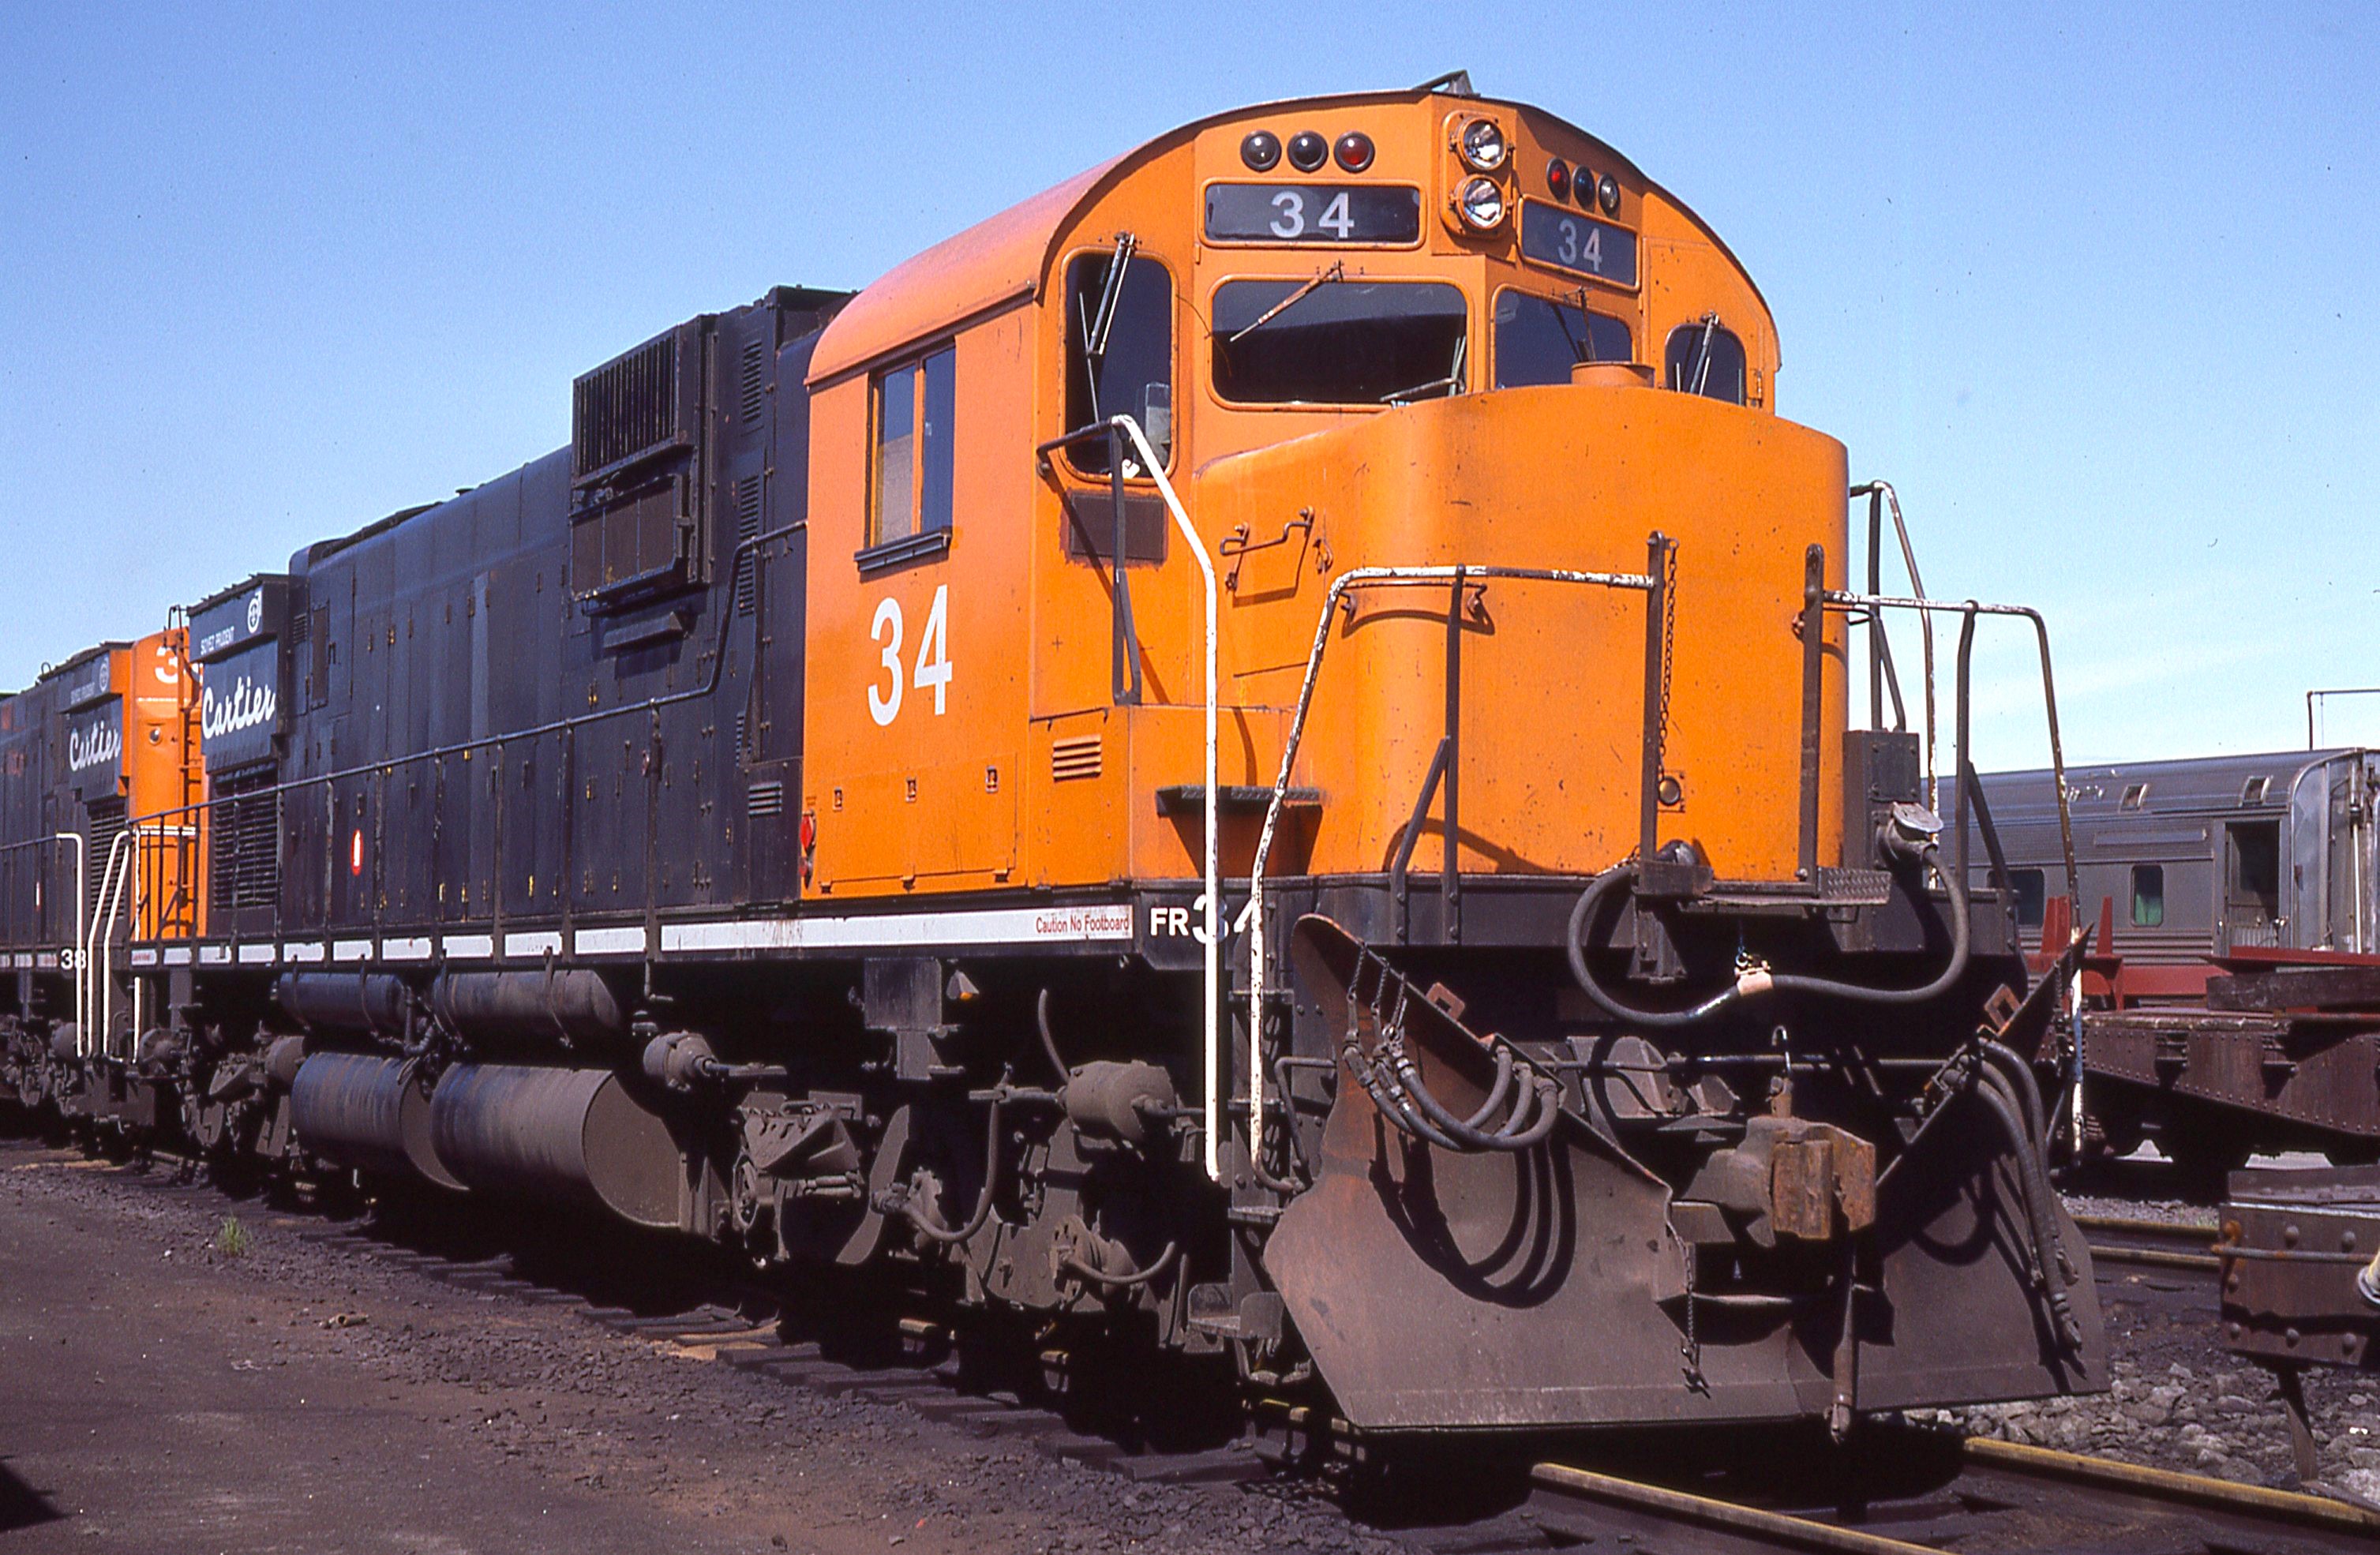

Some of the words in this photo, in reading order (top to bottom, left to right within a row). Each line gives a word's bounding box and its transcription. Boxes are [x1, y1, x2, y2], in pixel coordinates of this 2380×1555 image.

[1269, 191, 1355, 238] 34
[1557, 220, 1602, 272] 34
[868, 584, 953, 726] 34
[202, 676, 276, 740] Cartier
[69, 720, 122, 772] Cartier
[1036, 916, 1068, 934] Caution
[1070, 916, 1082, 932] No
[1085, 913, 1130, 931] Footboard
[1150, 907, 1190, 936] FR
